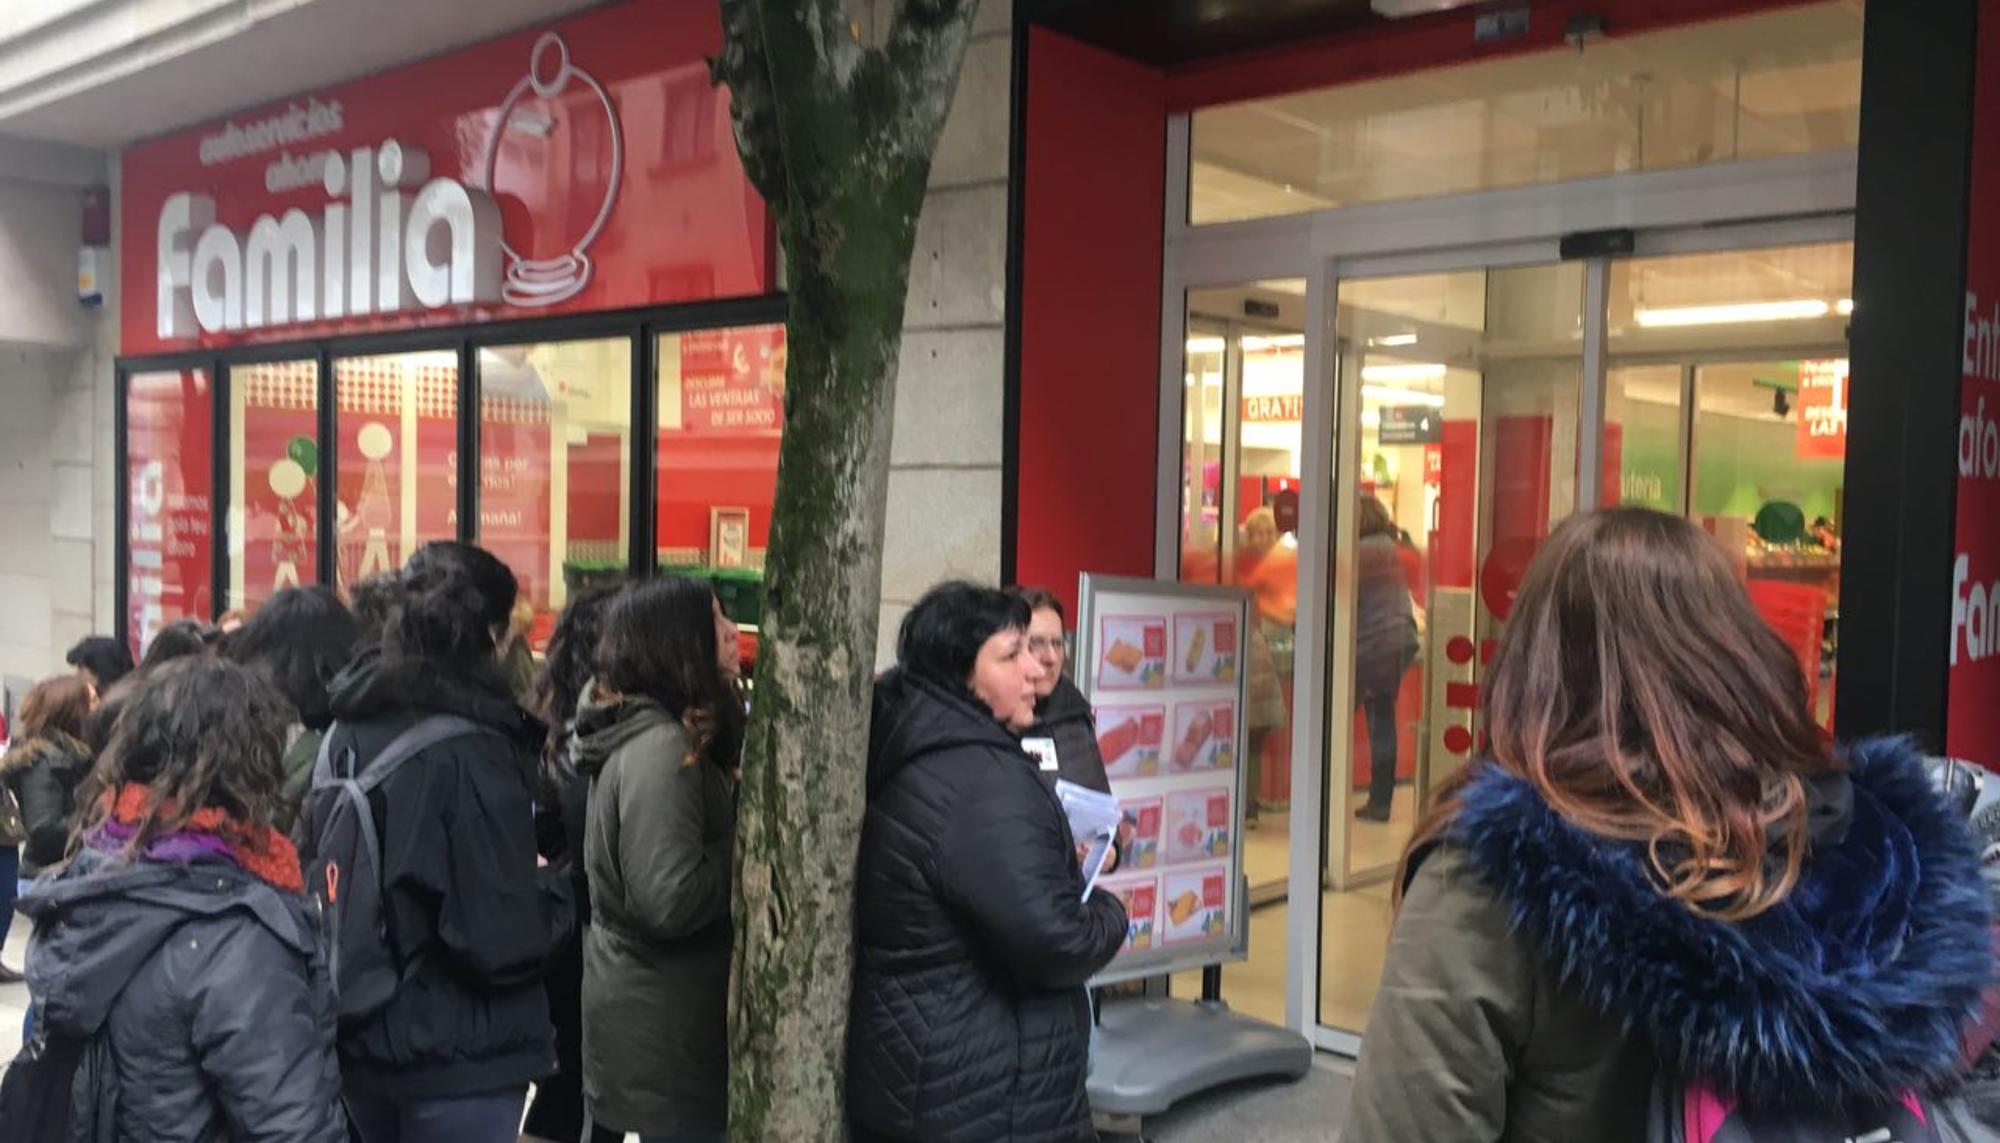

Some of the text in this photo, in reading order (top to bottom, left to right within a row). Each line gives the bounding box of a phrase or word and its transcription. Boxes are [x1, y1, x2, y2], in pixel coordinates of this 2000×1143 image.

[689, 387, 760, 409] LAS VENTAJAS
[1248, 397, 1300, 419] GRATI
[1958, 395, 2000, 478] afo
